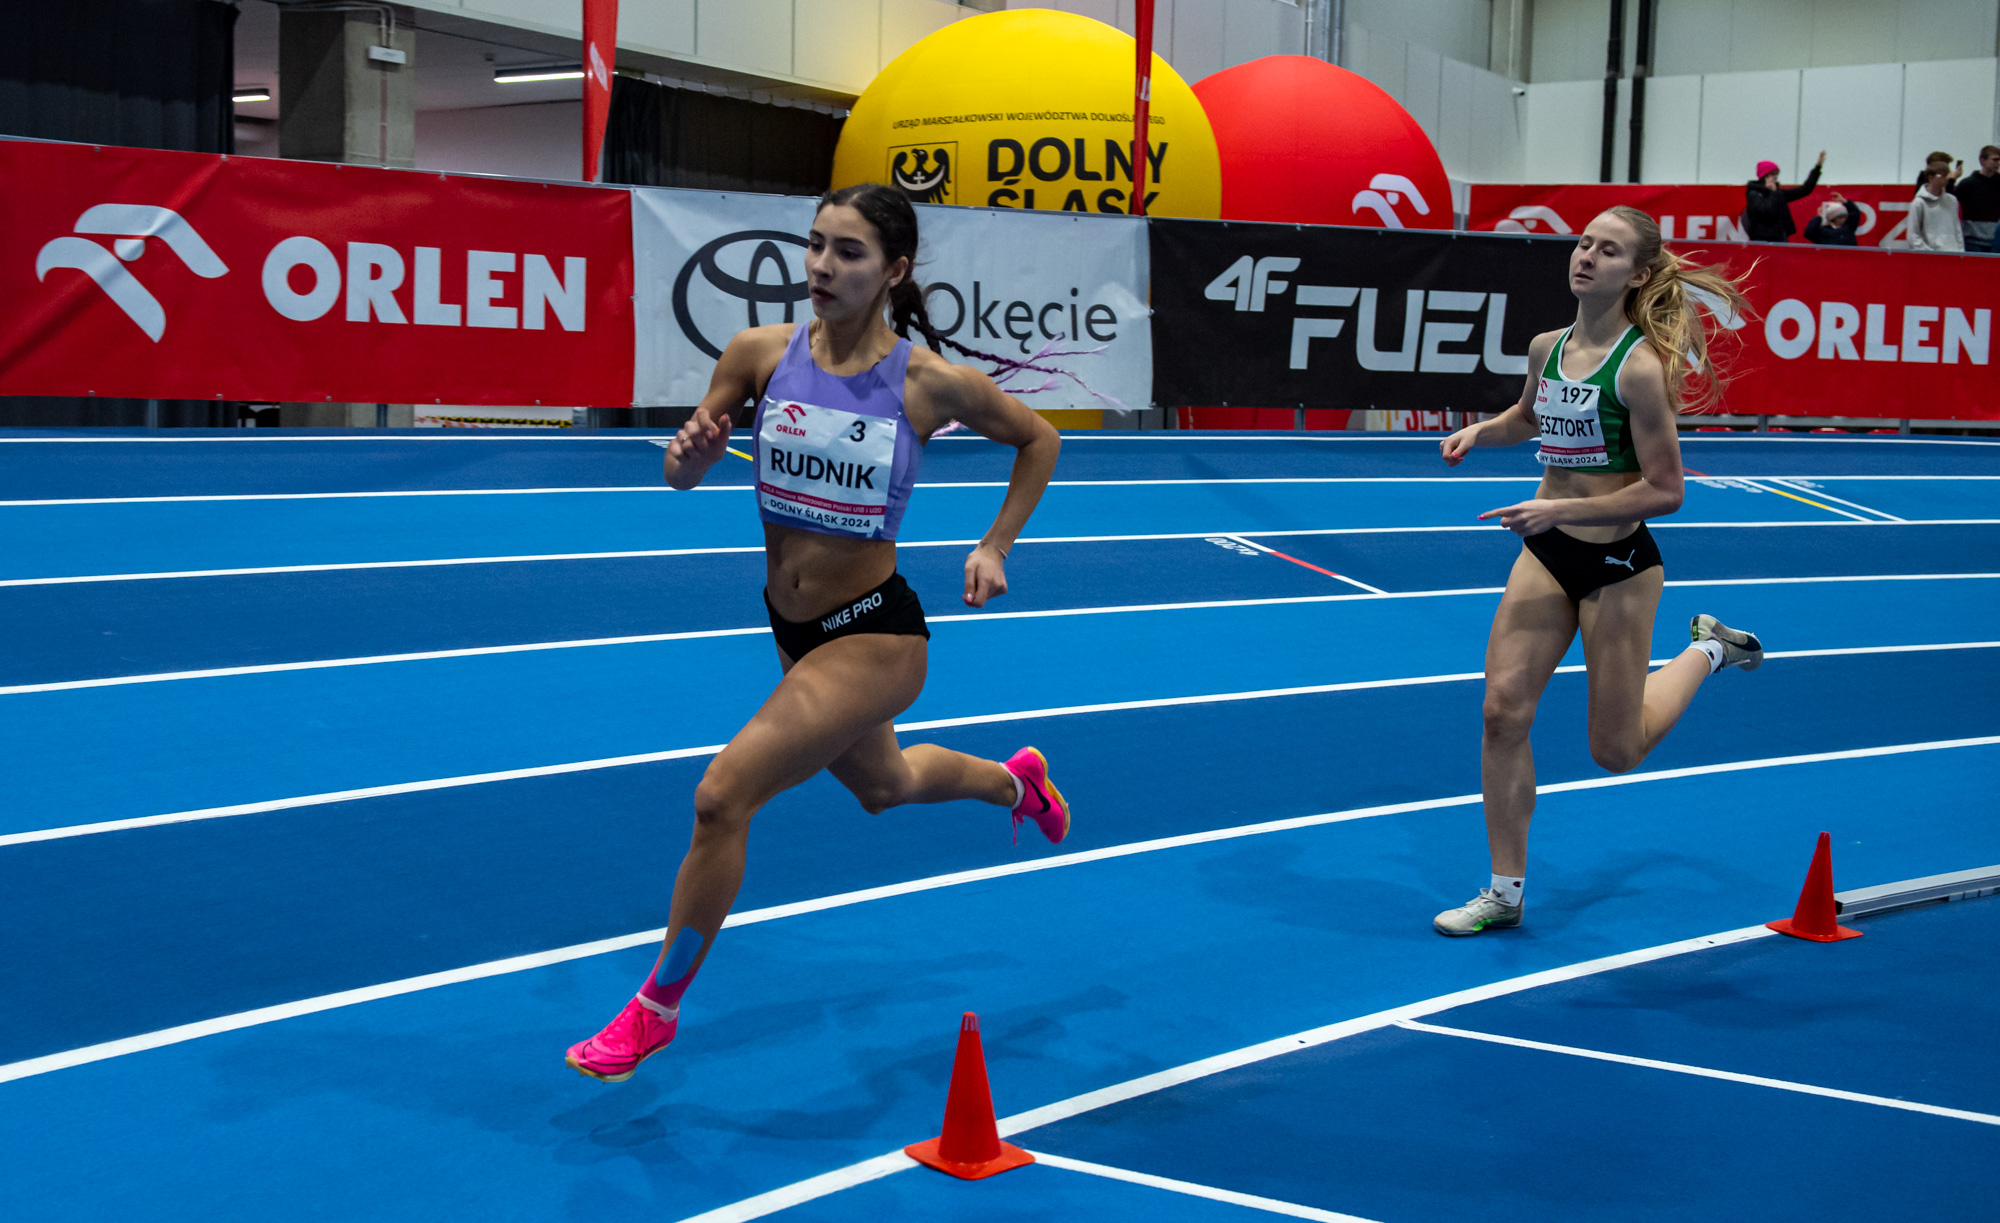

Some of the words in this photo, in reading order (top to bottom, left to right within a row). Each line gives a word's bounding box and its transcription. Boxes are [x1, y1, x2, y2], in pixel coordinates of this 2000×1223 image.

[1006, 110, 1088, 121] WOJEWÓDZTWA
[987, 136, 1169, 184] DOLNY
[261, 235, 587, 333] ORLEN
[1204, 255, 1301, 312] 4F
[921, 280, 1118, 354] Okęcie
[1289, 284, 1530, 376] FUEL
[1764, 297, 1992, 366] ORLEN
[1561, 386, 1593, 405] 197
[776, 424, 806, 437] ORLEN
[849, 420, 866, 442] 3
[1539, 414, 1595, 437] ESZTORT
[770, 447, 876, 490] RUDNIK
[1550, 455, 1574, 465] ŚLĄSK
[1575, 456, 1598, 464] 2024
[769, 499, 803, 515] DOLNY
[804, 508, 839, 526] ŚLĄSK
[841, 517, 871, 528] 2024
[821, 608, 852, 633] NIKE
[852, 592, 883, 619] PRO
